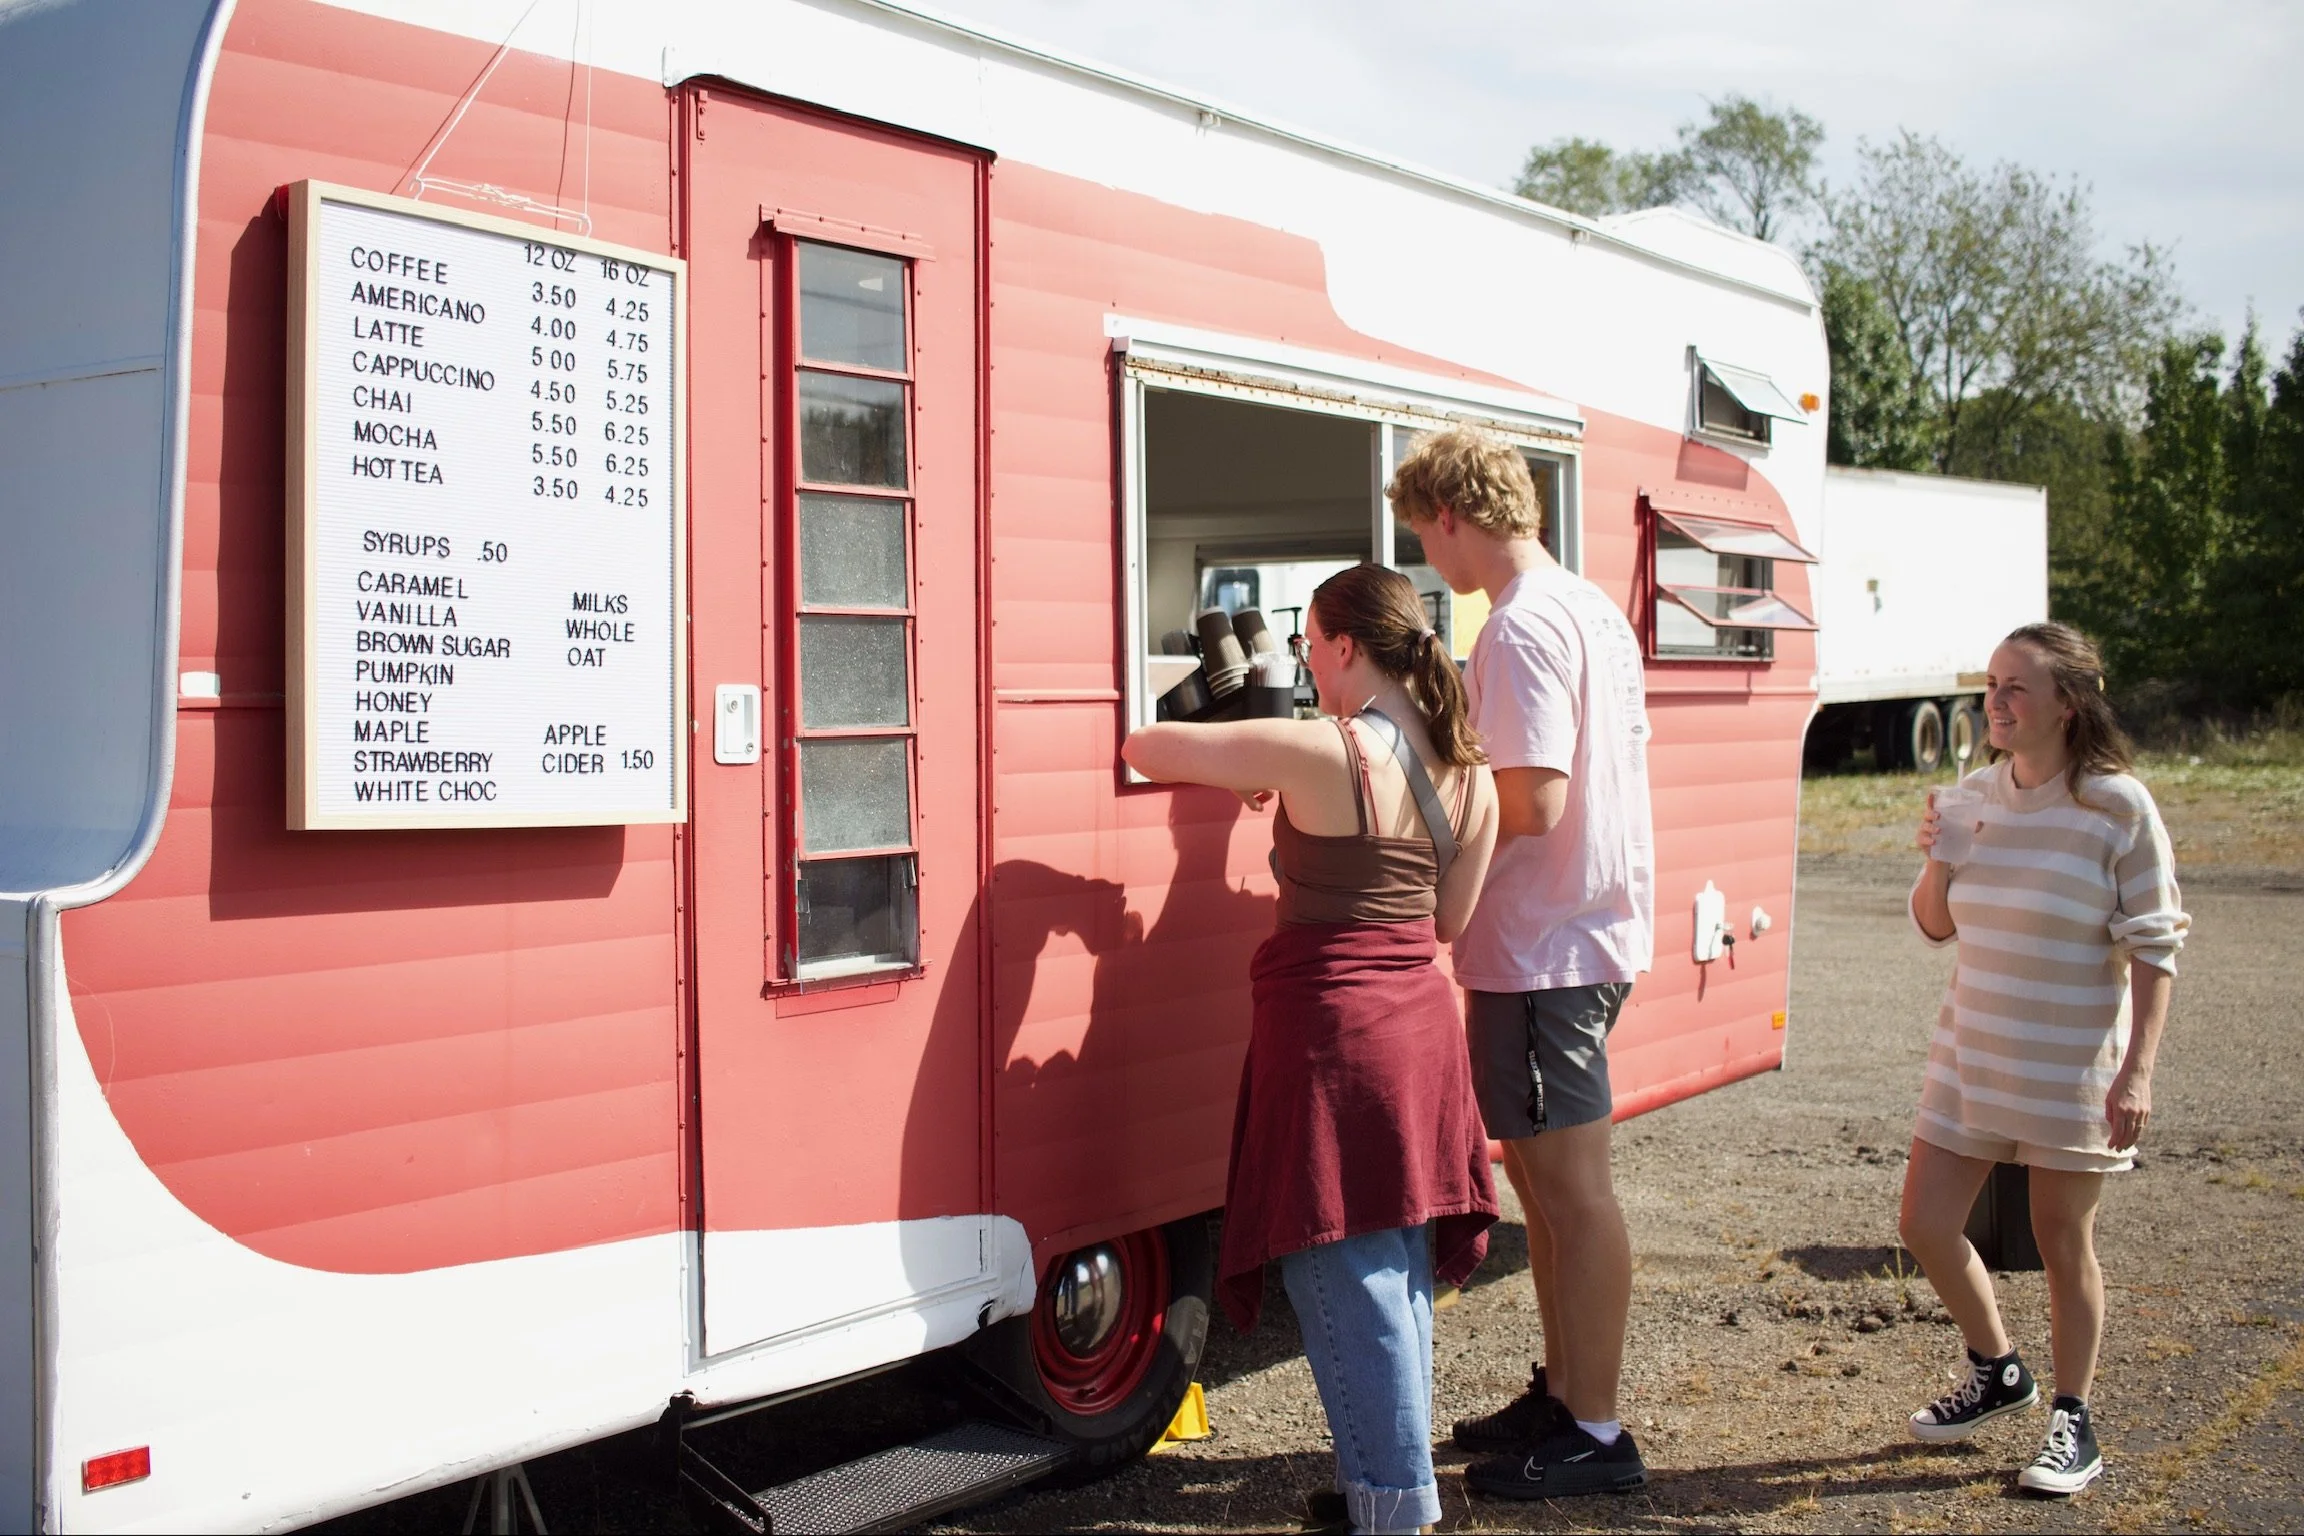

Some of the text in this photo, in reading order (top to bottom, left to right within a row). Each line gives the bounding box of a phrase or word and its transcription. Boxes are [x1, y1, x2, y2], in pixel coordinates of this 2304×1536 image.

[524, 243, 650, 287] 12 OZ 16 OZ
[350, 245, 649, 322] COFFEE 3.50 4.25
[349, 280, 648, 353] AMERICANO 4.00 4.75
[353, 315, 424, 347] LATTE
[607, 358, 648, 383] 5.75
[352, 350, 648, 415] CAPPUCCINO 4.50 5.25
[352, 384, 648, 446] CHAI 5.50 6.25
[353, 419, 648, 477] MOCHA 5.50 6.25
[351, 454, 648, 507] HOT TEA 3.50 4.25
[363, 529, 507, 563] SYRUPS .50
[357, 569, 468, 599] CARAMEL
[355, 599, 457, 627] VANILLA
[571, 591, 628, 614] MILKS
[356, 629, 510, 658] BROWN SUGAR
[565, 618, 635, 642] WHOLE
[567, 646, 606, 667] OAT
[355, 659, 453, 686] PUMPKIN
[355, 690, 432, 713] HONEY
[353, 719, 429, 743] MAPLE
[543, 723, 606, 746] APPLE
[353, 749, 493, 773] STRAWBERRY
[541, 748, 653, 774] CIDER 1.50
[353, 779, 496, 802] WHITE CHOC
